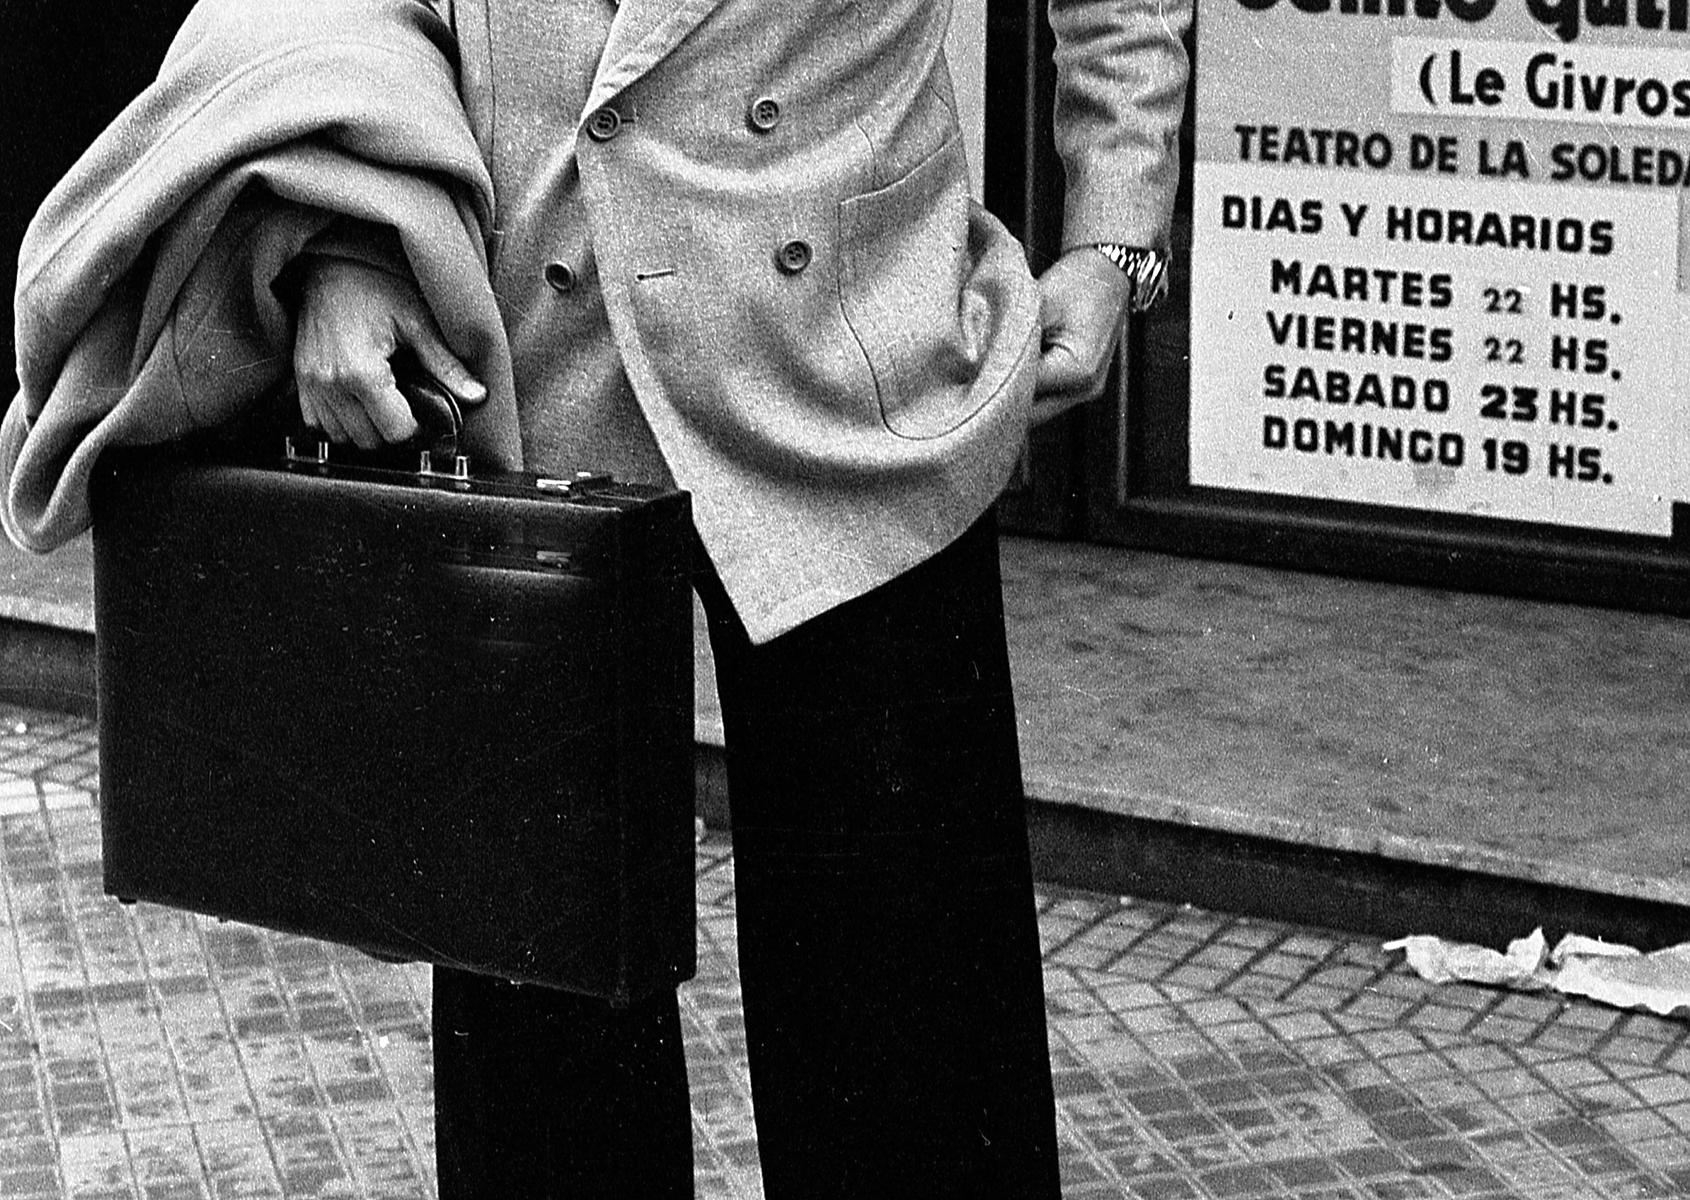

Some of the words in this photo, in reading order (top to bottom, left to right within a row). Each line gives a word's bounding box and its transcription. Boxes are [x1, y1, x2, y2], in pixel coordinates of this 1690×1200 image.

[1234, 123, 1393, 170] TEATRO
[1409, 132, 1458, 174] DE
[1478, 138, 1530, 179] LA
[1222, 195, 1323, 235] DIAS
[1340, 203, 1368, 238] Y
[1387, 206, 1614, 256] HORARIOS
[1271, 259, 1453, 308] MARTES
[1482, 287, 1524, 315] 22
[1551, 282, 1621, 325] HS.
[1266, 310, 1453, 362] VIERNES
[1483, 336, 1525, 365] 22
[1551, 334, 1621, 381] HS.
[1264, 364, 1450, 413] SABADO
[1480, 383, 1539, 422] 23
[1550, 388, 1619, 432] HS.
[1263, 415, 1464, 468] DOMINGO
[1482, 437, 1530, 476] 19
[1549, 442, 1614, 485] HS.
